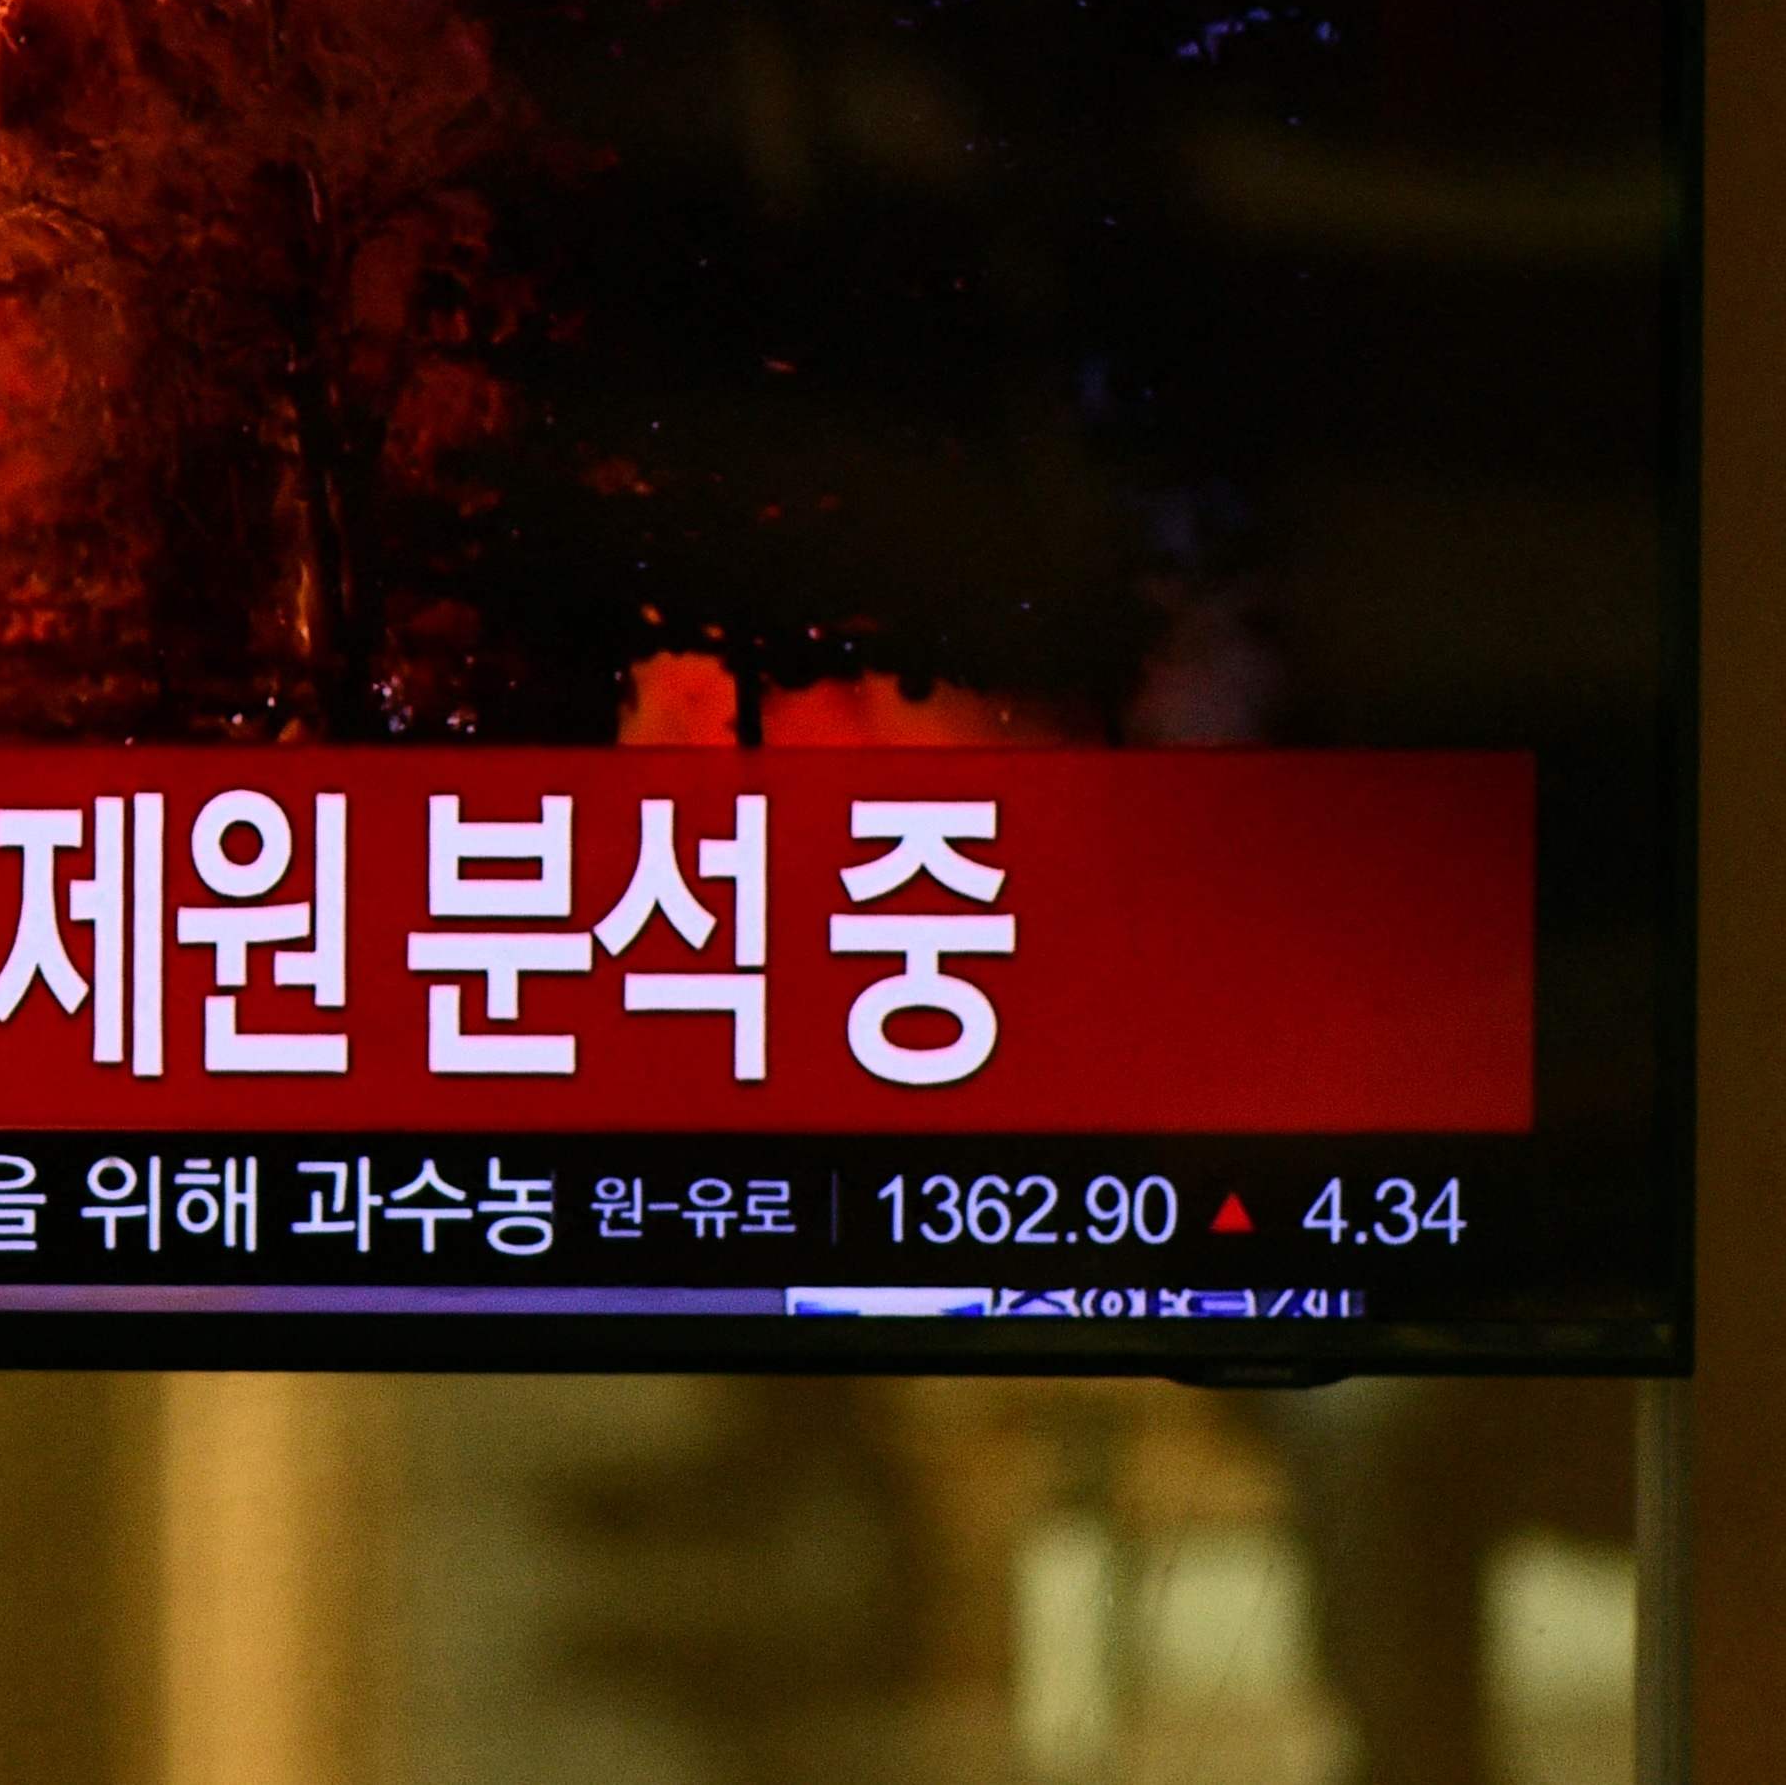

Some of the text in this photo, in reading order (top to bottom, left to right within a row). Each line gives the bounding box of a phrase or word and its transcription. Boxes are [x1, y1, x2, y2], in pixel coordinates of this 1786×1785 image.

[406, 793, 768, 1082] 분석
[829, 799, 1017, 1086] 중
[80, 1155, 258, 1253] 위해
[291, 1155, 554, 1256] 과수농
[590, 1174, 1468, 1247] 원-유로 1362.90 4.34
